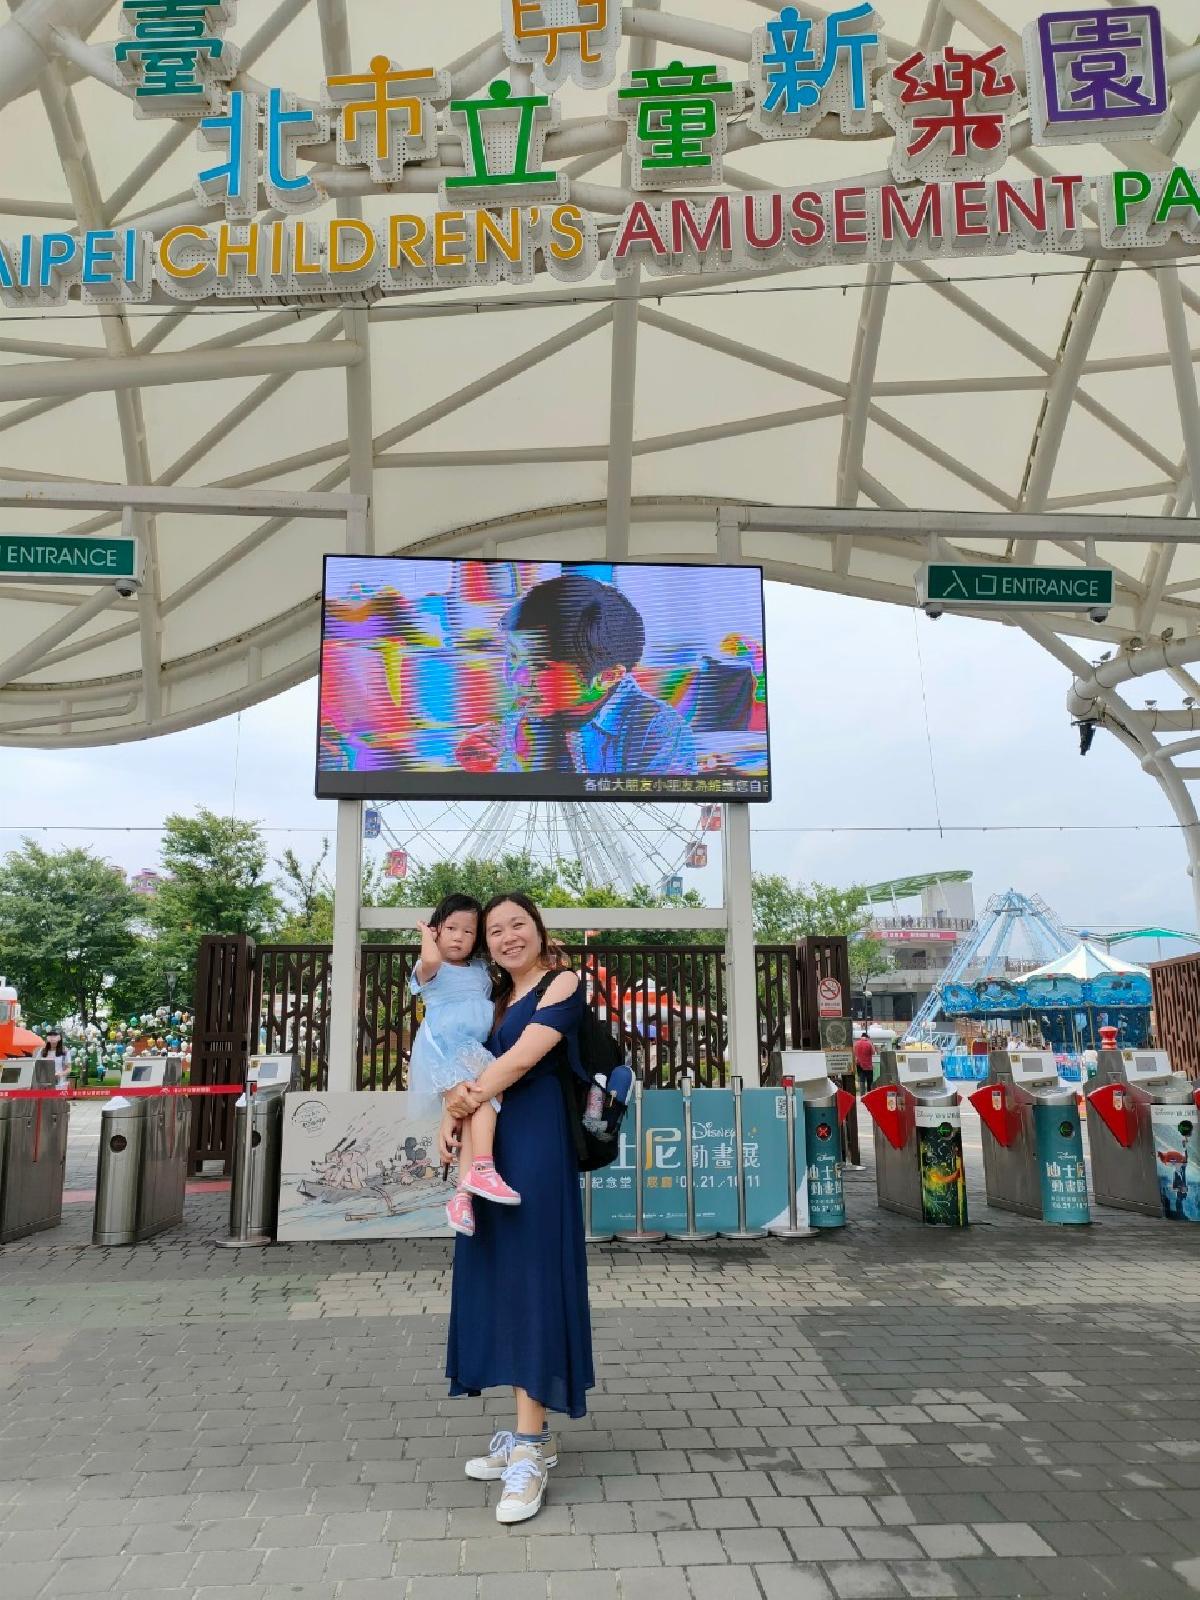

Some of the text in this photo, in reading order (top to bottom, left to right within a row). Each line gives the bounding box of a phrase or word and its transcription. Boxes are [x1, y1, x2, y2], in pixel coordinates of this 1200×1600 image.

[159, 204, 586, 279] CHILDREN'S
[615, 175, 1084, 259] AMUSEMENT
[7, 546, 118, 567] ENTRANCE
[942, 569, 997, 598] 入口
[1002, 577, 1099, 598] ENTRANCE
